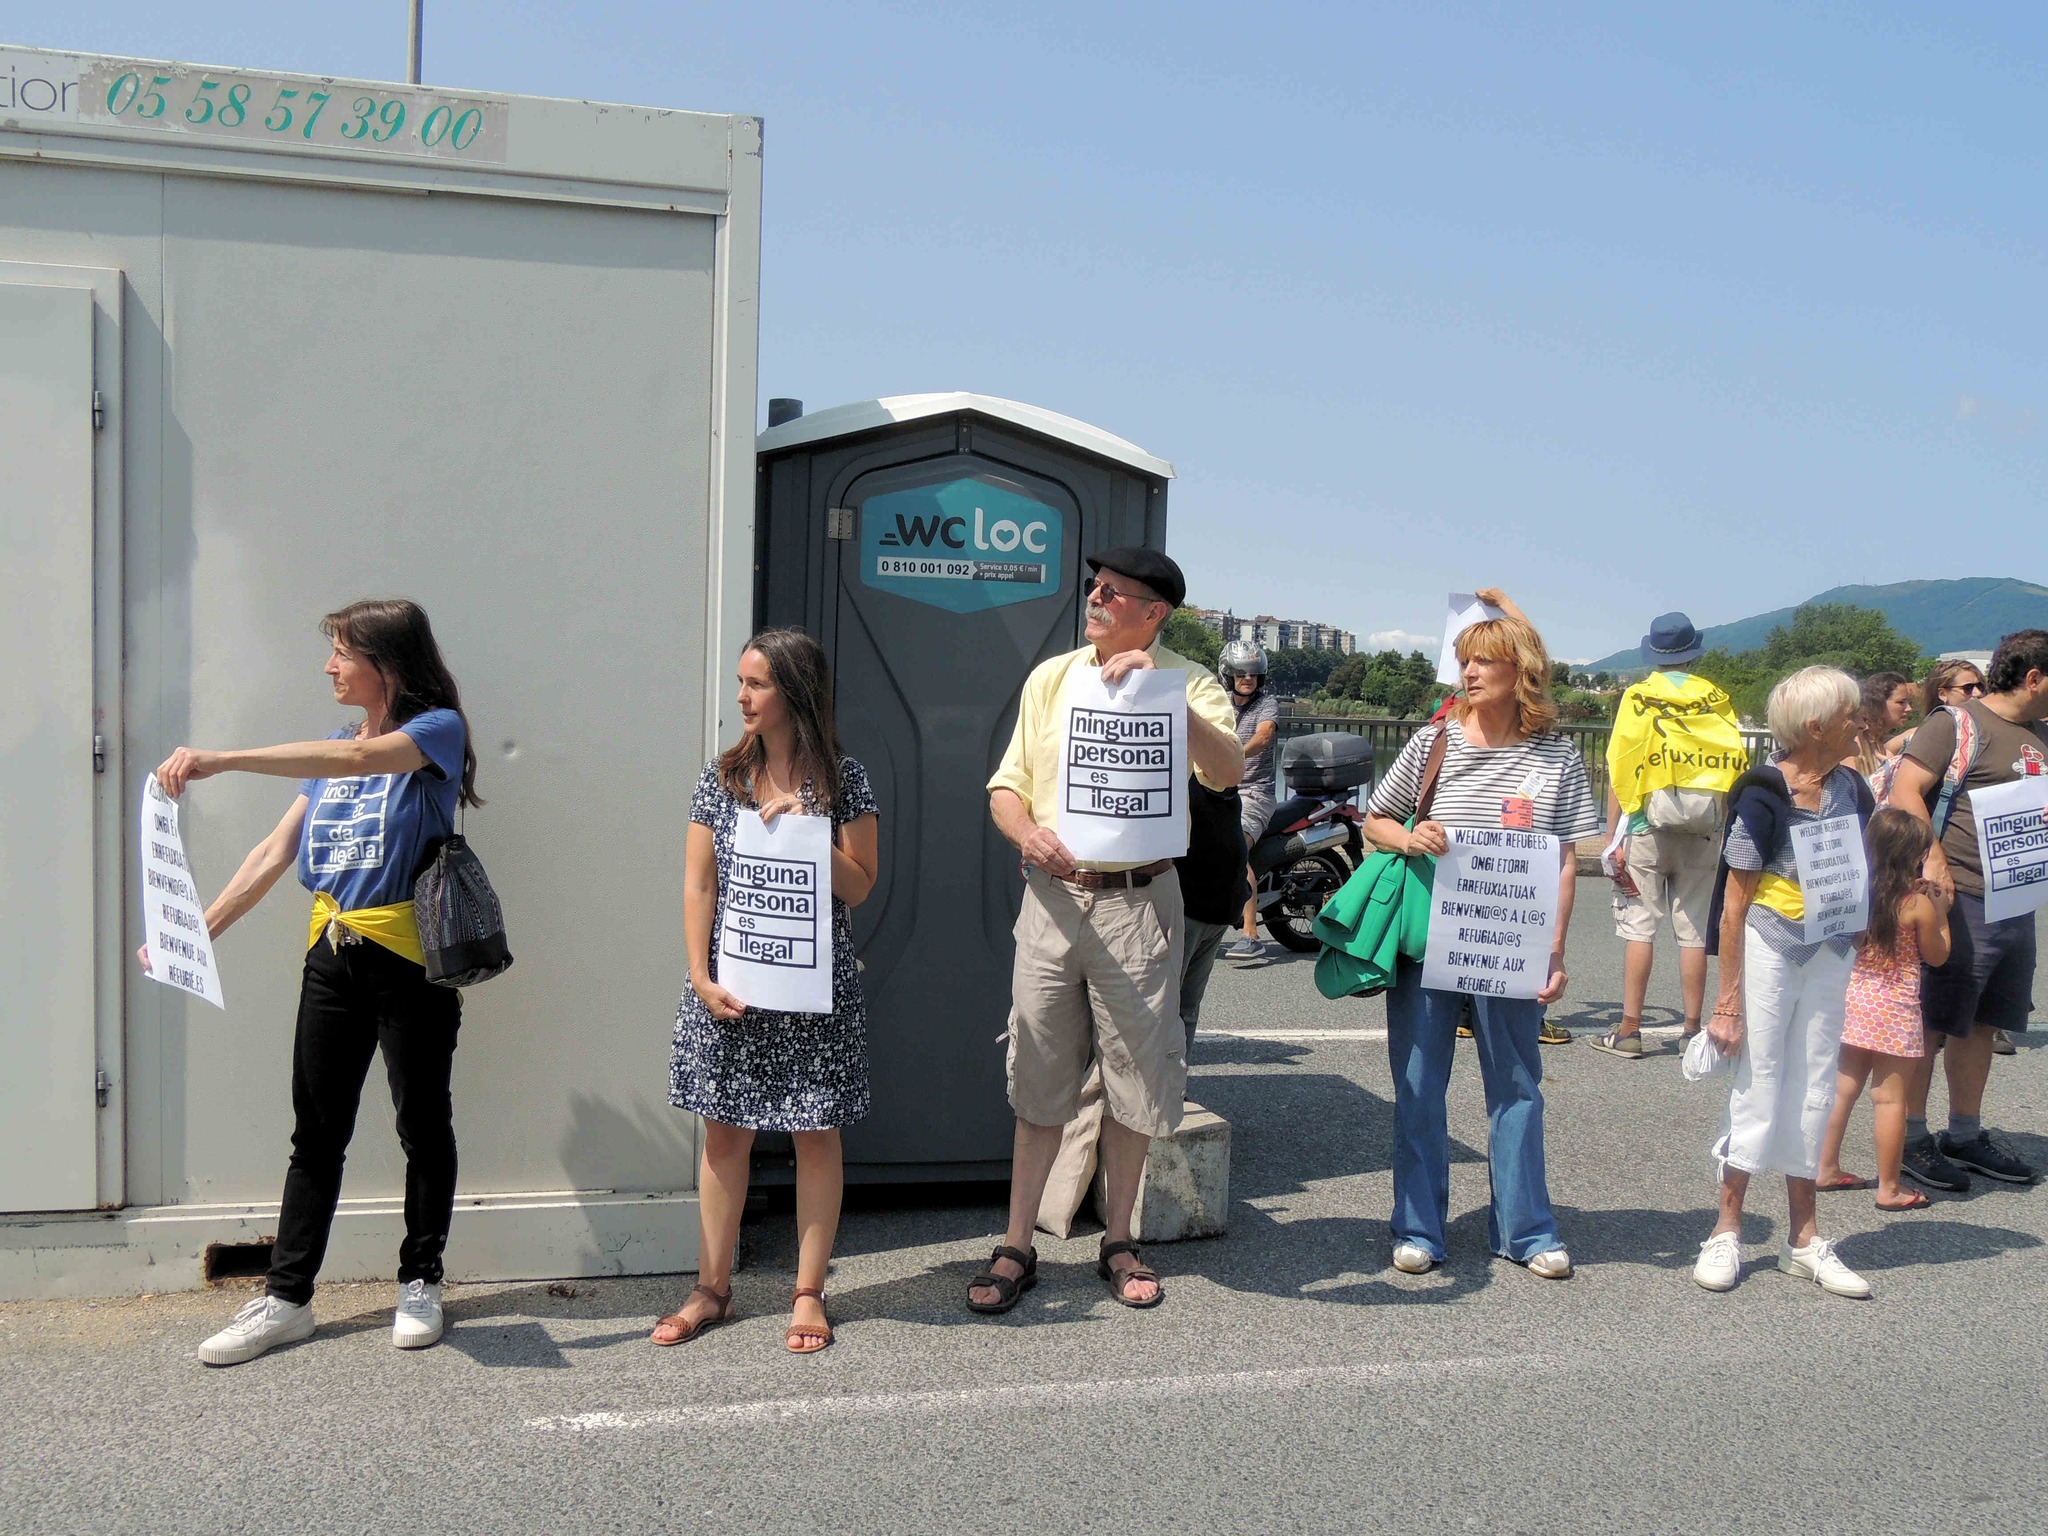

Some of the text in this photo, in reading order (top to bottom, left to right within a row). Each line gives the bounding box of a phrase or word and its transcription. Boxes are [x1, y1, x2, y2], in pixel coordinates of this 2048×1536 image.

[107, 73, 482, 150] 05 58 57 39 00
[882, 561, 969, 576] 0 810 001 092
[979, 563, 1002, 571] Service
[1003, 564, 1018, 572] 0,05
[998, 572, 1014, 581] appel
[1075, 711, 1164, 742] ninguna
[1074, 743, 1165, 766] persona
[1090, 772, 1109, 784] es
[323, 783, 359, 799] inor
[1091, 788, 1149, 817] ilegal
[328, 824, 354, 841] da
[1989, 814, 2042, 834] ningun
[1455, 829, 1548, 850] WELCOME REFUGEES
[1471, 855, 1529, 874] ONGI ETORRI
[2007, 856, 2020, 866] es
[2008, 861, 2046, 884] ilegal
[1456, 878, 1537, 900] ERREFUXIATUAK
[729, 887, 809, 914] persona
[738, 915, 756, 929] es
[1441, 901, 1546, 926] BIENVENID@S A L@S
[739, 934, 793, 961] ilegal
[1458, 928, 1522, 948] REFUGIAD@S
[1448, 951, 1526, 972] BIENVENUE AUX
[1457, 974, 1507, 995] RÉFUGIÉ.ES
